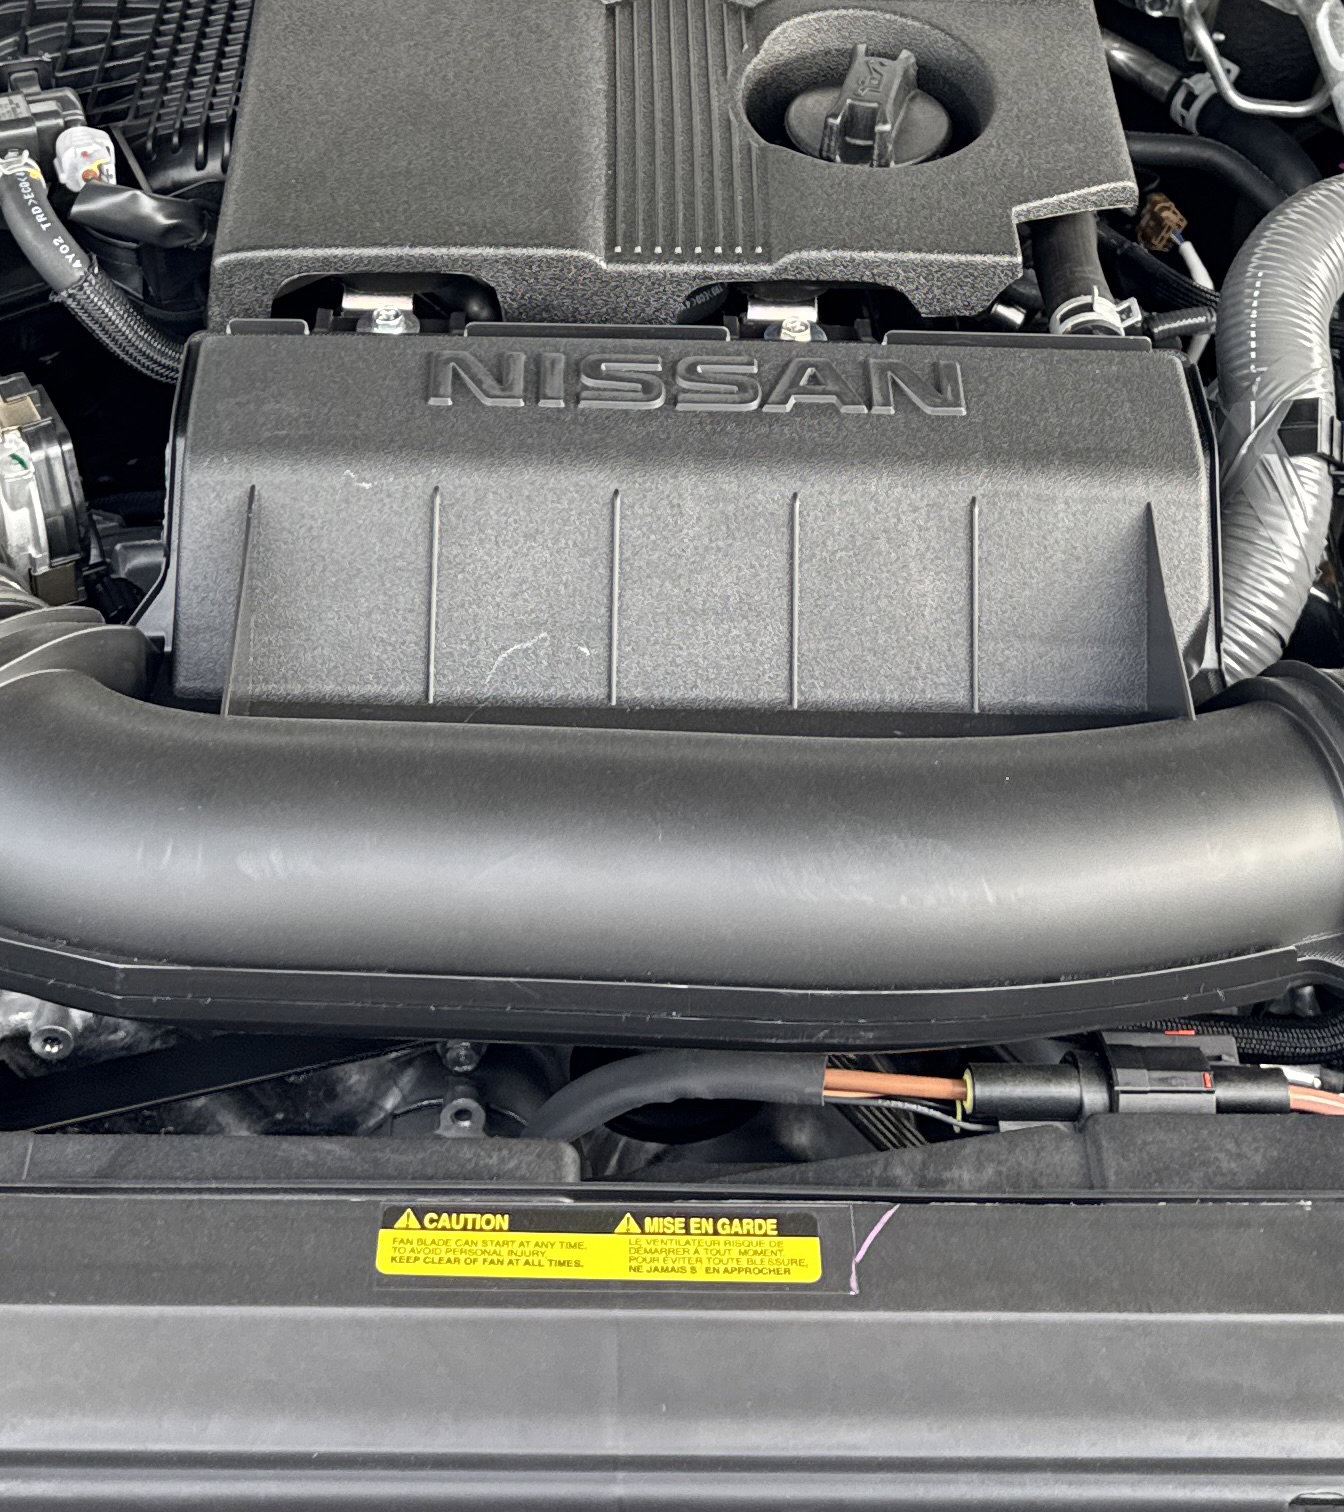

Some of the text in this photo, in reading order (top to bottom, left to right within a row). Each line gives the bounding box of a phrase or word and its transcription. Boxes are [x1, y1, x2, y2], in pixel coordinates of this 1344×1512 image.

[428, 350, 967, 416] NISSAN
[423, 1213, 509, 1230] CAUTION
[644, 1216, 778, 1235] MISE EN GARDE
[392, 1237, 414, 1246] FAN
[416, 1238, 452, 1247] BLADE
[455, 1238, 479, 1248] CAN
[481, 1239, 516, 1248] START
[518, 1240, 532, 1249] AT
[534, 1240, 556, 1249] ANY
[628, 1238, 784, 1248] LE VENTILATEUR RISQUE DE
[392, 1246, 406, 1255] TO
[408, 1247, 442, 1256] AVOID
[445, 1248, 503, 1257] PERSONAL
[703, 1247, 733, 1256] TOUT
[391, 1256, 584, 1268] KEEP CLEAR OF FAN AT ALL TIMES.
[628, 1256, 659, 1264] POUR
[706, 1256, 742, 1265] TOUTE
[628, 1265, 644, 1273] NE
[646, 1266, 687, 1274] JAMAIS
[722, 1267, 792, 1276] APPROCHER
